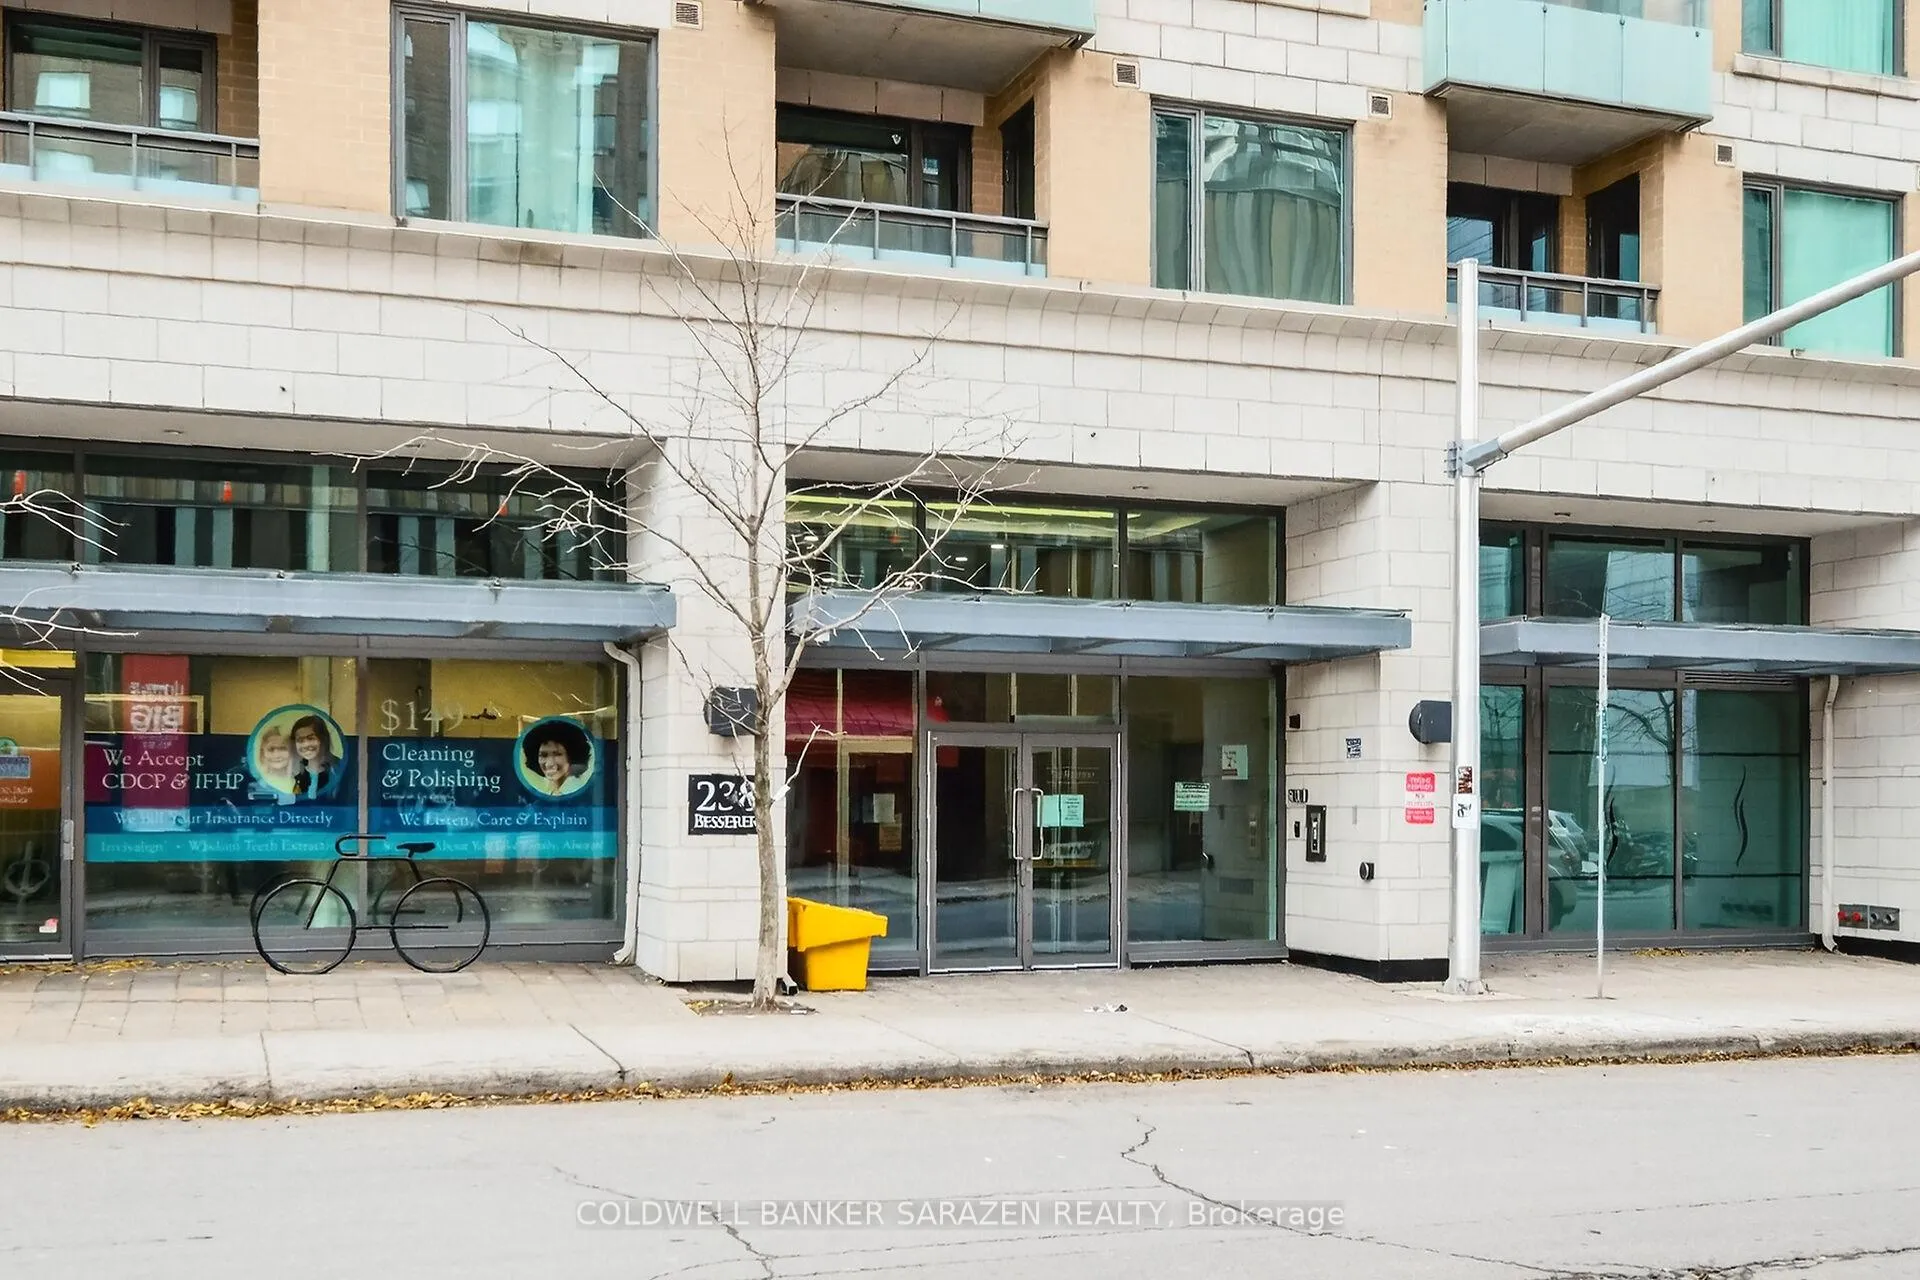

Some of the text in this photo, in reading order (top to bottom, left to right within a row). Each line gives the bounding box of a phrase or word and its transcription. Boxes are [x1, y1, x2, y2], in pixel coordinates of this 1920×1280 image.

[380, 698, 464, 734] $149
[102, 748, 204, 771] We Accept
[382, 743, 475, 767] Cleaning
[102, 773, 244, 789] CDCP & IFHP
[381, 768, 501, 793] & Polishing
[114, 811, 136, 825] We
[206, 811, 274, 825] Insurance
[279, 810, 333, 828] Directly
[400, 812, 421, 826] We
[477, 811, 513, 826] Care
[516, 811, 531, 826] &
[533, 811, 588, 829] Explain
